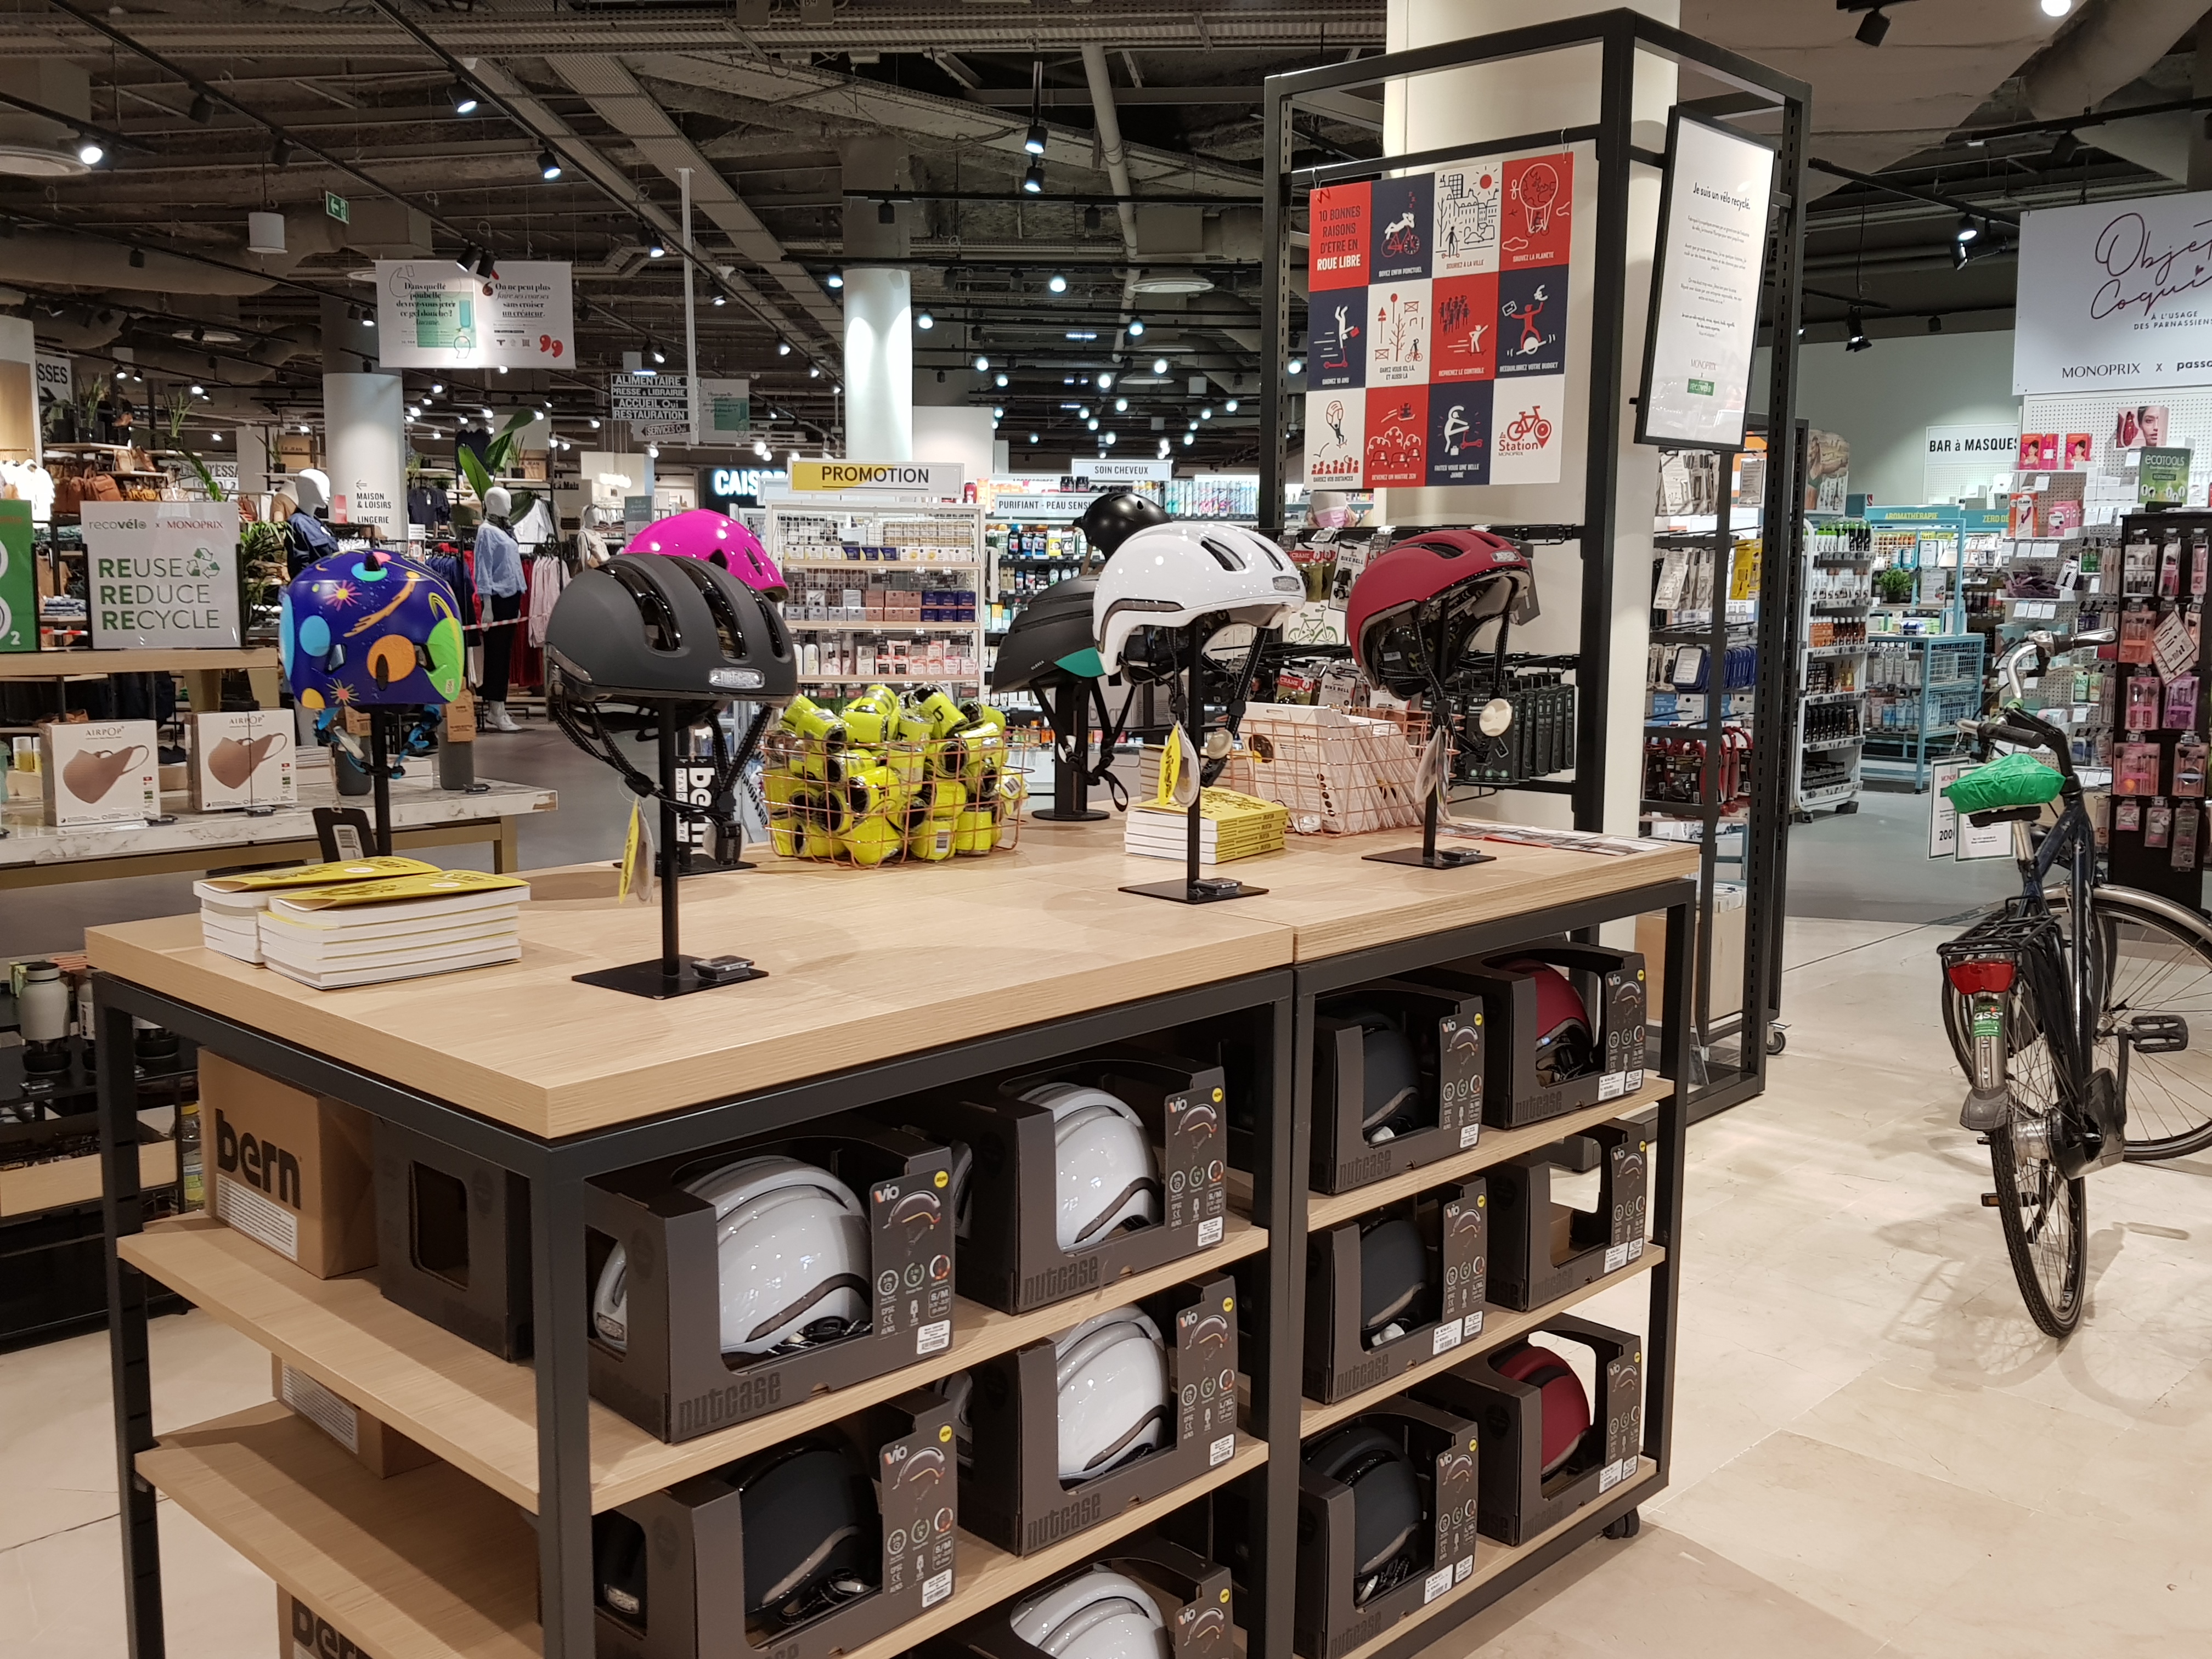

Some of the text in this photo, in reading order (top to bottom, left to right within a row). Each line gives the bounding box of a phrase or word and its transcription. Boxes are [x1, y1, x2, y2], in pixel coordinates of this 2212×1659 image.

[1693, 182, 1699, 194] Je
[1700, 186, 1711, 198] suis
[1712, 192, 1719, 200] un
[1720, 191, 1730, 203] vélo
[1319, 206, 1361, 222] 10 BONNES
[1322, 223, 1356, 238] RAISONS
[1348, 239, 1358, 251] EN
[1317, 254, 1361, 271] ROUE LIBRE
[404, 282, 423, 291] Dans
[517, 283, 534, 292] peut
[534, 283, 551, 292] plus
[410, 292, 441, 301] poubelle
[2161, 311, 2198, 319] L'USAGE
[1690, 358, 1717, 371] MONOPRIX
[2062, 363, 2141, 379] MONOPRIX
[616, 375, 681, 386] ALIMENTAIRE
[613, 388, 641, 397] PRESSE
[648, 388, 685, 397] LIBRAIRIE
[619, 398, 679, 409] ACCUEIL Oui
[614, 410, 685, 420] RESTAURATION
[647, 424, 676, 436] SERVICES
[1499, 439, 1538, 452] Station
[1929, 439, 1951, 452] BAR
[1955, 440, 1961, 451] à
[821, 466, 929, 483] PROMOTION
[1094, 465, 1149, 475] SOIN CHEVEUX
[714, 470, 789, 496] CAIS
[357, 492, 385, 500] MAISON
[365, 500, 392, 509] LOISIRS
[998, 500, 1039, 510] PURIFIANT
[1046, 500, 1066, 510] PEAU
[167, 520, 224, 529] MONOPRIX
[357, 515, 390, 524] LINGERIE
[1983, 514, 1999, 523] ZÉRO
[98, 558, 183, 578] REUSE
[100, 584, 211, 605] REDUCE
[102, 609, 221, 630] RECYCLE
[1279, 677, 1299, 685] CRANE
[229, 715, 262, 725] AIRPOP
[85, 727, 122, 737] AIRPOP
[216, 1108, 301, 1210] bern
[1339, 1149, 1391, 1184] nutcase
[1024, 1256, 1099, 1306] nutcase
[930, 1289, 949, 1301] S/M
[1336, 1354, 1389, 1396] nutcase
[679, 1372, 781, 1435] nutcase
[1028, 1492, 1101, 1550] nutcase
[935, 1540, 951, 1554] S/M
